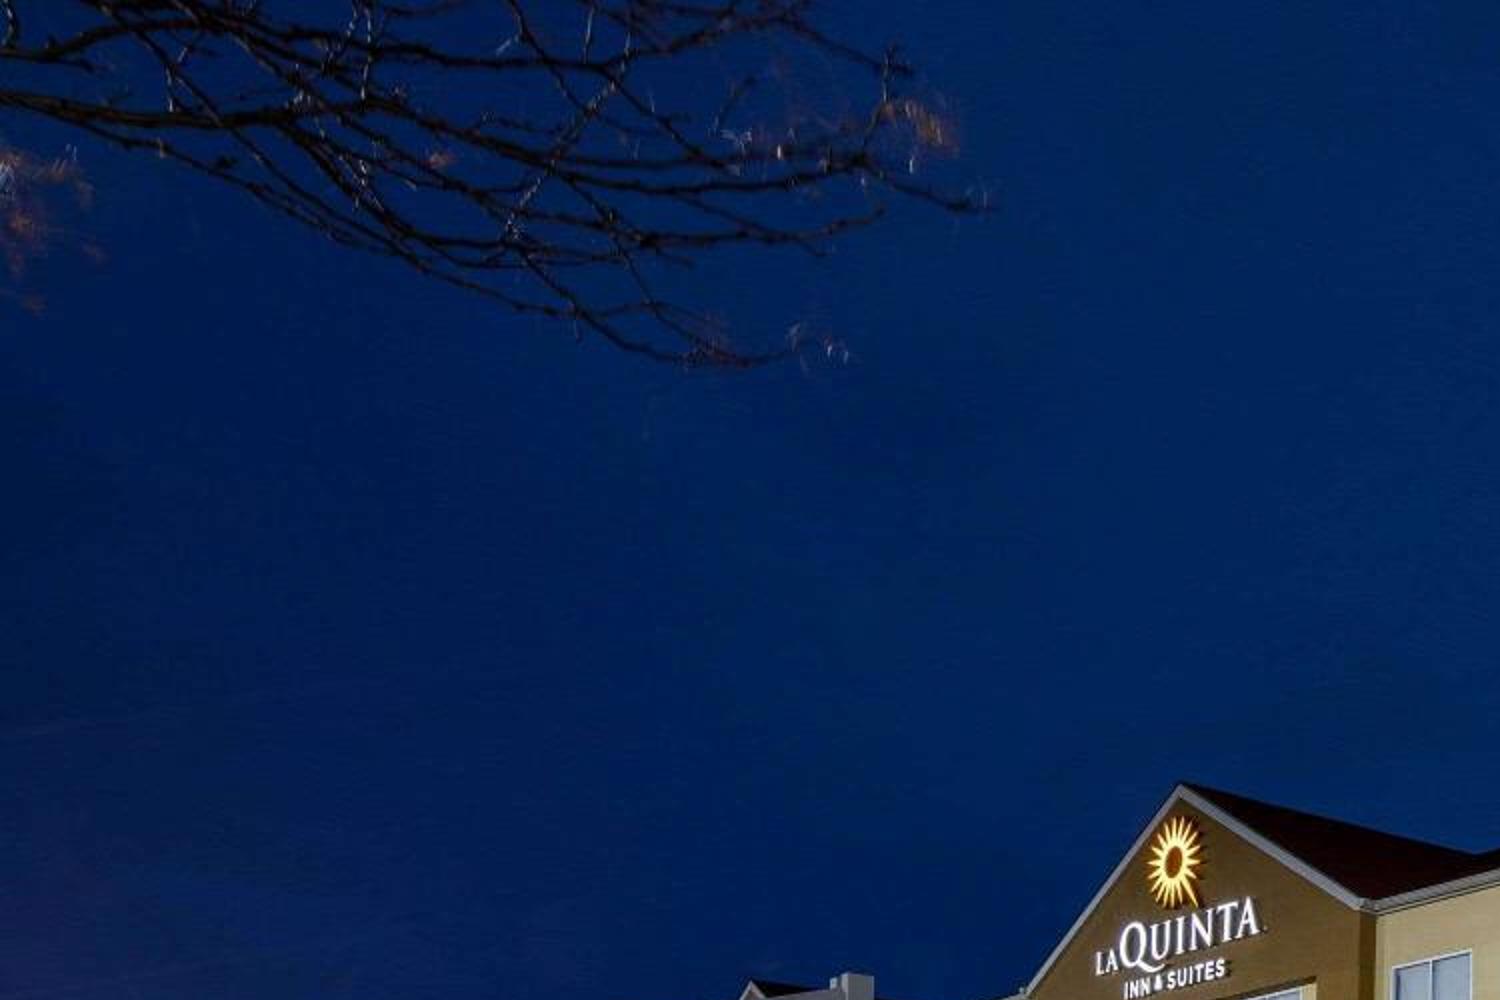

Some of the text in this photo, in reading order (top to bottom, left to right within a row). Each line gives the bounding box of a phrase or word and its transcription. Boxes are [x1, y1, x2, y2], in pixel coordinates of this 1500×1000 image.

[1095, 896, 1260, 976] LA QUINTA
[1123, 977, 1151, 1000] INN
[1167, 958, 1225, 989] SUITES
